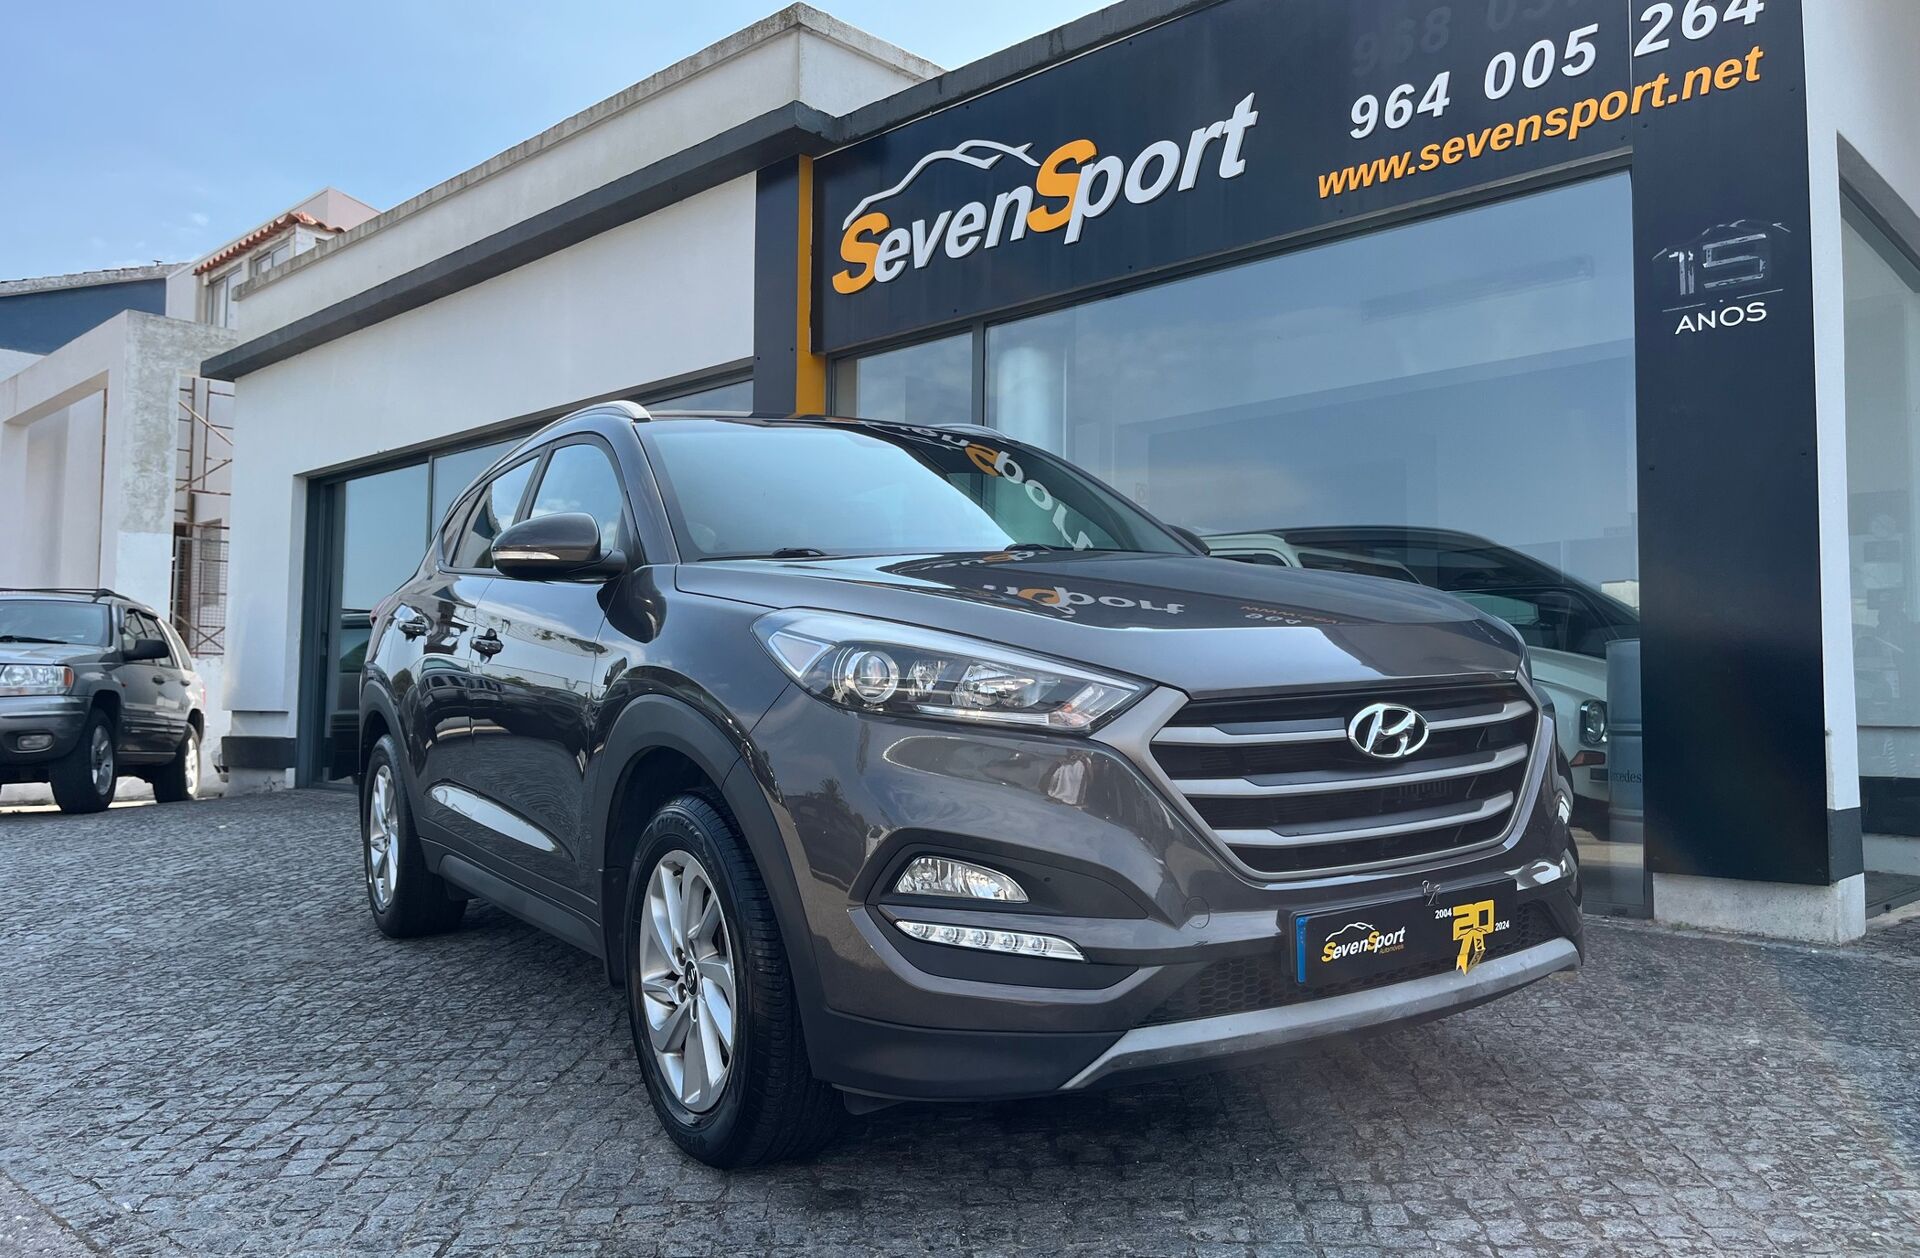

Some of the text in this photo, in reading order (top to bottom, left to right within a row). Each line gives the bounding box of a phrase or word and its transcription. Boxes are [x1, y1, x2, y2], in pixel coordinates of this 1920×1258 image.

[1349, 71, 1451, 140] 964
[1483, 23, 1598, 101] 005
[1633, 0, 1765, 57] 264
[1318, 46, 1765, 199] www.sevensport.net
[832, 91, 1258, 294] SevenSport
[1674, 301, 1768, 335] ANOS
[1434, 908, 1452, 919] 2004
[1494, 920, 1510, 932] 2024
[1321, 926, 1406, 963] SevenSport
